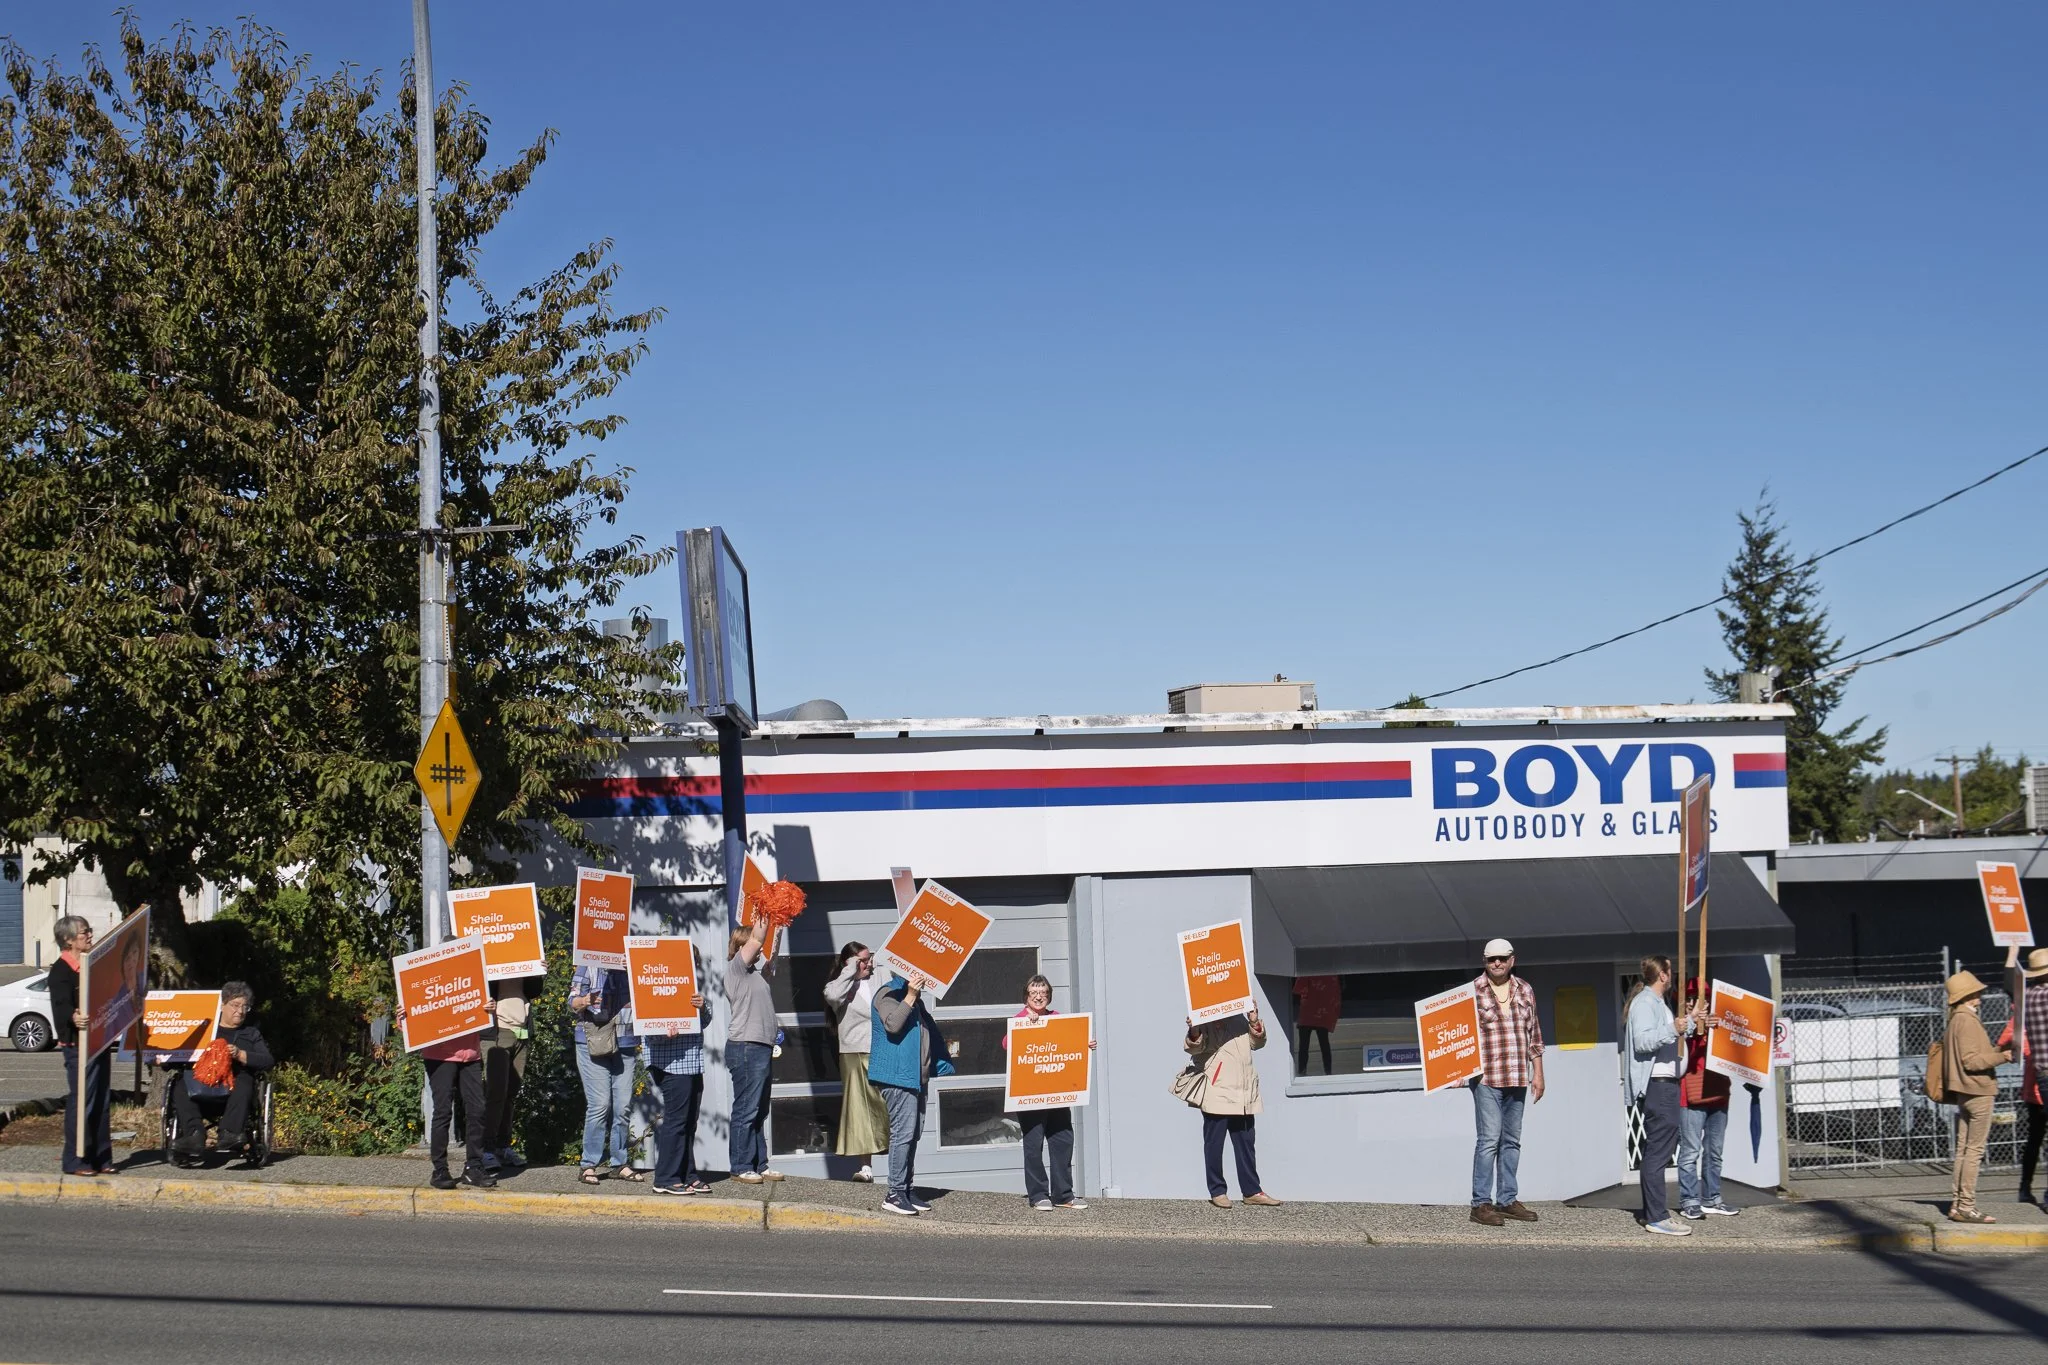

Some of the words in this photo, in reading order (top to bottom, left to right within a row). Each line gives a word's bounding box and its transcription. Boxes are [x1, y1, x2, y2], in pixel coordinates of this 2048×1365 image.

[1431, 743, 1716, 809] BOYD
[1435, 813, 1585, 842] AUTOBODY
[1601, 812, 1617, 837] &
[1633, 810, 1718, 835] GLAS
[929, 885, 956, 904] RE-ELECT
[588, 896, 610, 908] Sheila
[471, 913, 503, 925] Sheila
[583, 906, 625, 921] Malcolmson
[463, 922, 530, 936] Malcolmson
[922, 912, 951, 933] Sheila
[910, 916, 965, 955] Malcolmson
[1184, 931, 1207, 940] RE-ELECT
[407, 951, 441, 965] WORKING
[442, 948, 455, 956] FOR
[456, 943, 471, 951] YOU
[582, 953, 600, 961] ACTION
[1197, 952, 1221, 965] Sheila
[643, 964, 669, 974] Sheila
[887, 956, 911, 972] ACTION
[1191, 958, 1241, 977] Malcolmson
[411, 975, 442, 989] RE-ELECT
[637, 975, 690, 985] Malcolmson
[424, 976, 471, 1000] Sheila
[410, 989, 481, 1016] Malcolmson
[1200, 1009, 1220, 1018] ACTION
[1233, 1001, 1245, 1009] YOU
[1425, 998, 1447, 1010] WORKING
[146, 1011, 182, 1019] Sheila
[1725, 1010, 1749, 1025] Sheila
[644, 1021, 665, 1029] ACTION
[1437, 1023, 1469, 1044] Sheila
[1026, 1042, 1058, 1054] Sheila
[1428, 1036, 1475, 1060] Malcolmson
[1017, 1052, 1082, 1065] Malcolmson
[1391, 1052, 1414, 1061] Repair
[1018, 1097, 1045, 1105] ACTION
